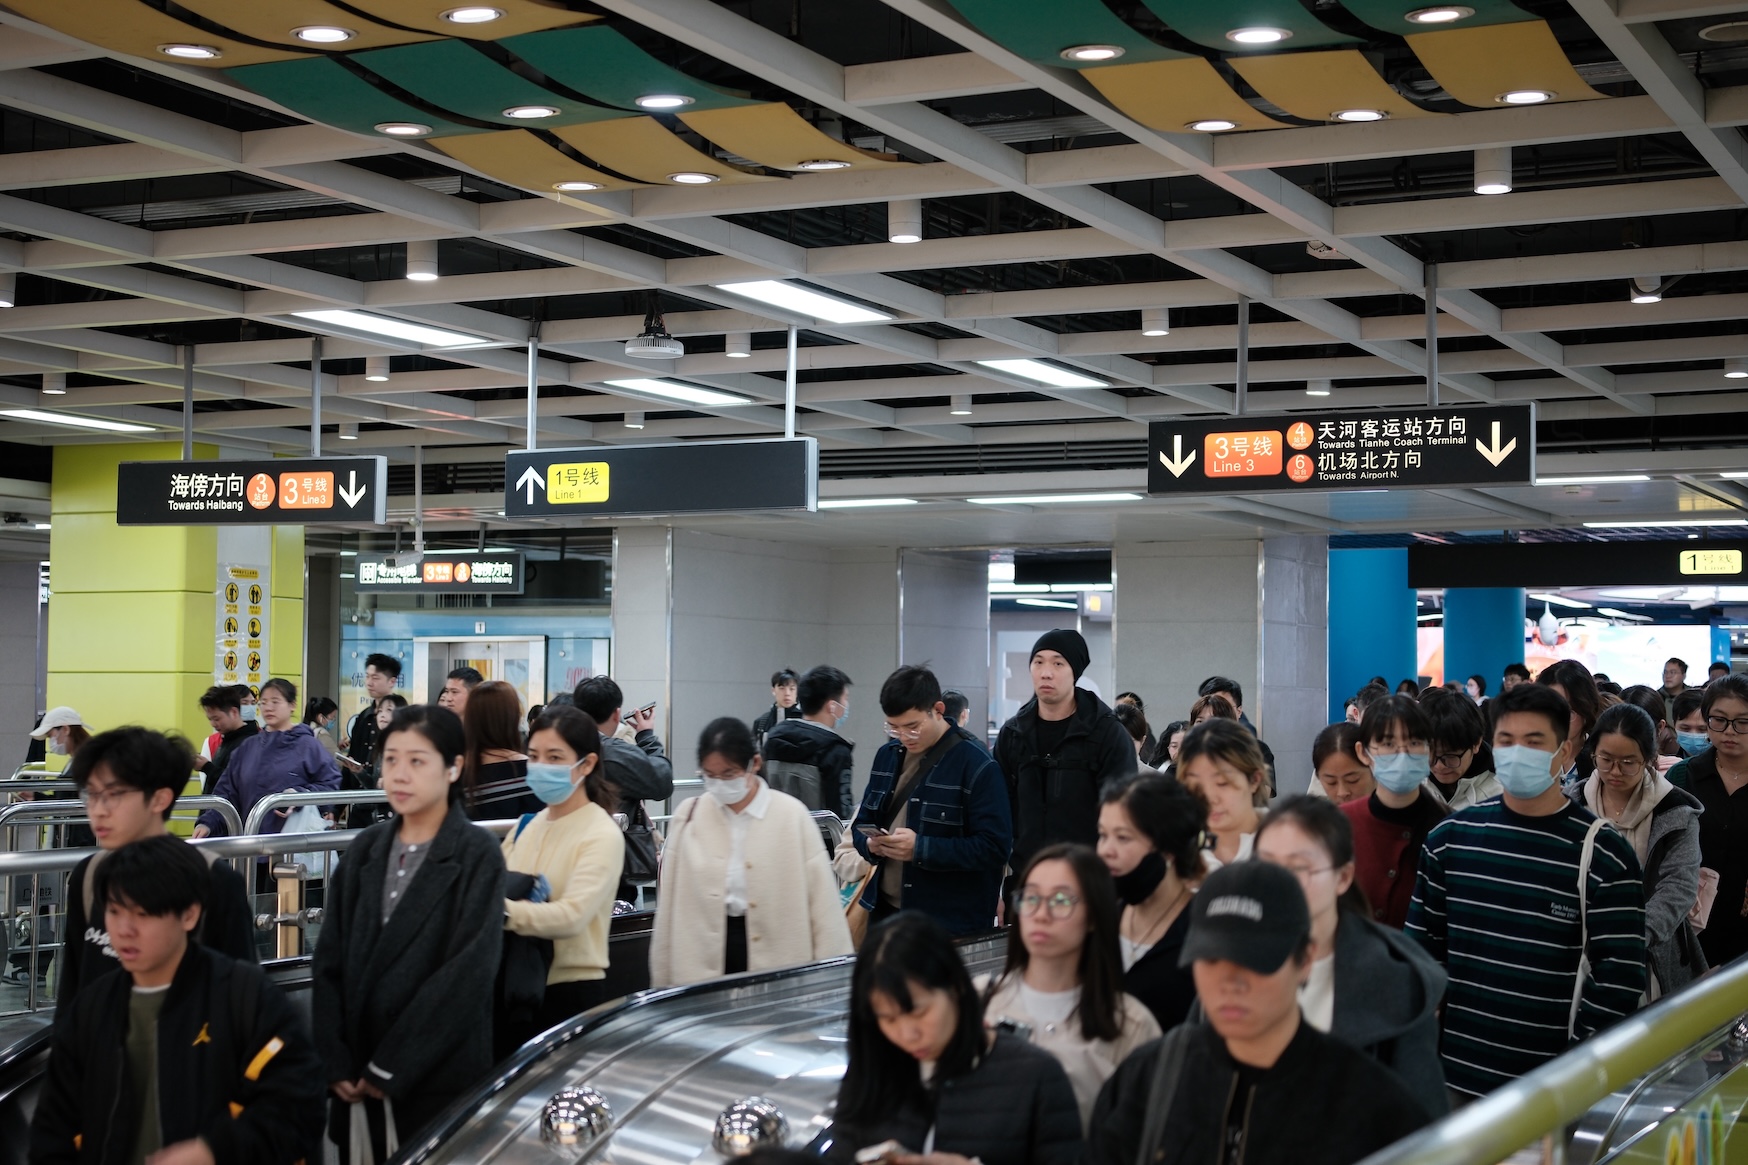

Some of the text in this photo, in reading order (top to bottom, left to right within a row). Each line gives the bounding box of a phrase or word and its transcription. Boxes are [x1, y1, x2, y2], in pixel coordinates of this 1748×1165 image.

[1295, 423, 1305, 437] 4
[1318, 415, 1466, 440] 天河客运站方向
[1214, 436, 1273, 459] 3号线
[1318, 435, 1467, 449] Towards Tianhe Coach Terminal
[1213, 459, 1254, 472] Line 3
[1295, 455, 1305, 469] 6
[1318, 449, 1422, 472] 机场北方向
[556, 467, 599, 487] 1号线
[1318, 470, 1399, 480] Towards Airport N.
[170, 472, 244, 498] 海傍方向
[256, 473, 267, 493] 3
[302, 494, 319, 505] Line
[555, 489, 582, 500] Line 1
[168, 500, 243, 512] Towards Haibang
